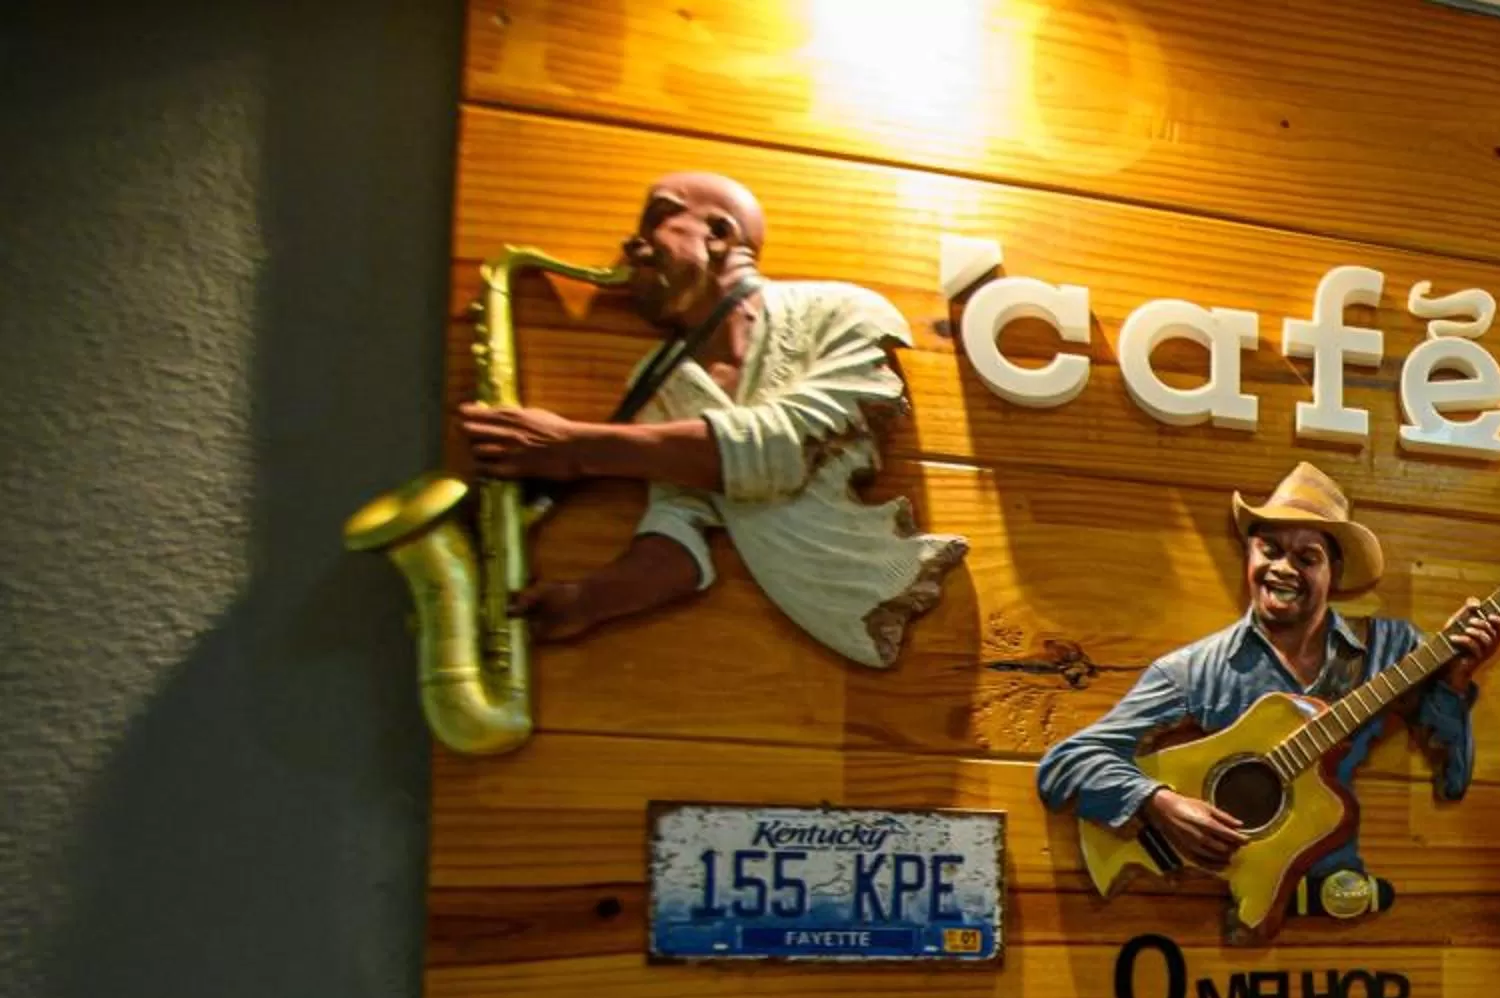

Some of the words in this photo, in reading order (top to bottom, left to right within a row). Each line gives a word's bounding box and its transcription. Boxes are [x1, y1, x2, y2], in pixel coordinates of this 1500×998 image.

[752, 819, 892, 852] Kentucky
[691, 850, 808, 919] 155
[853, 852, 965, 923] KPE
[784, 931, 872, 947] FAYETTE
